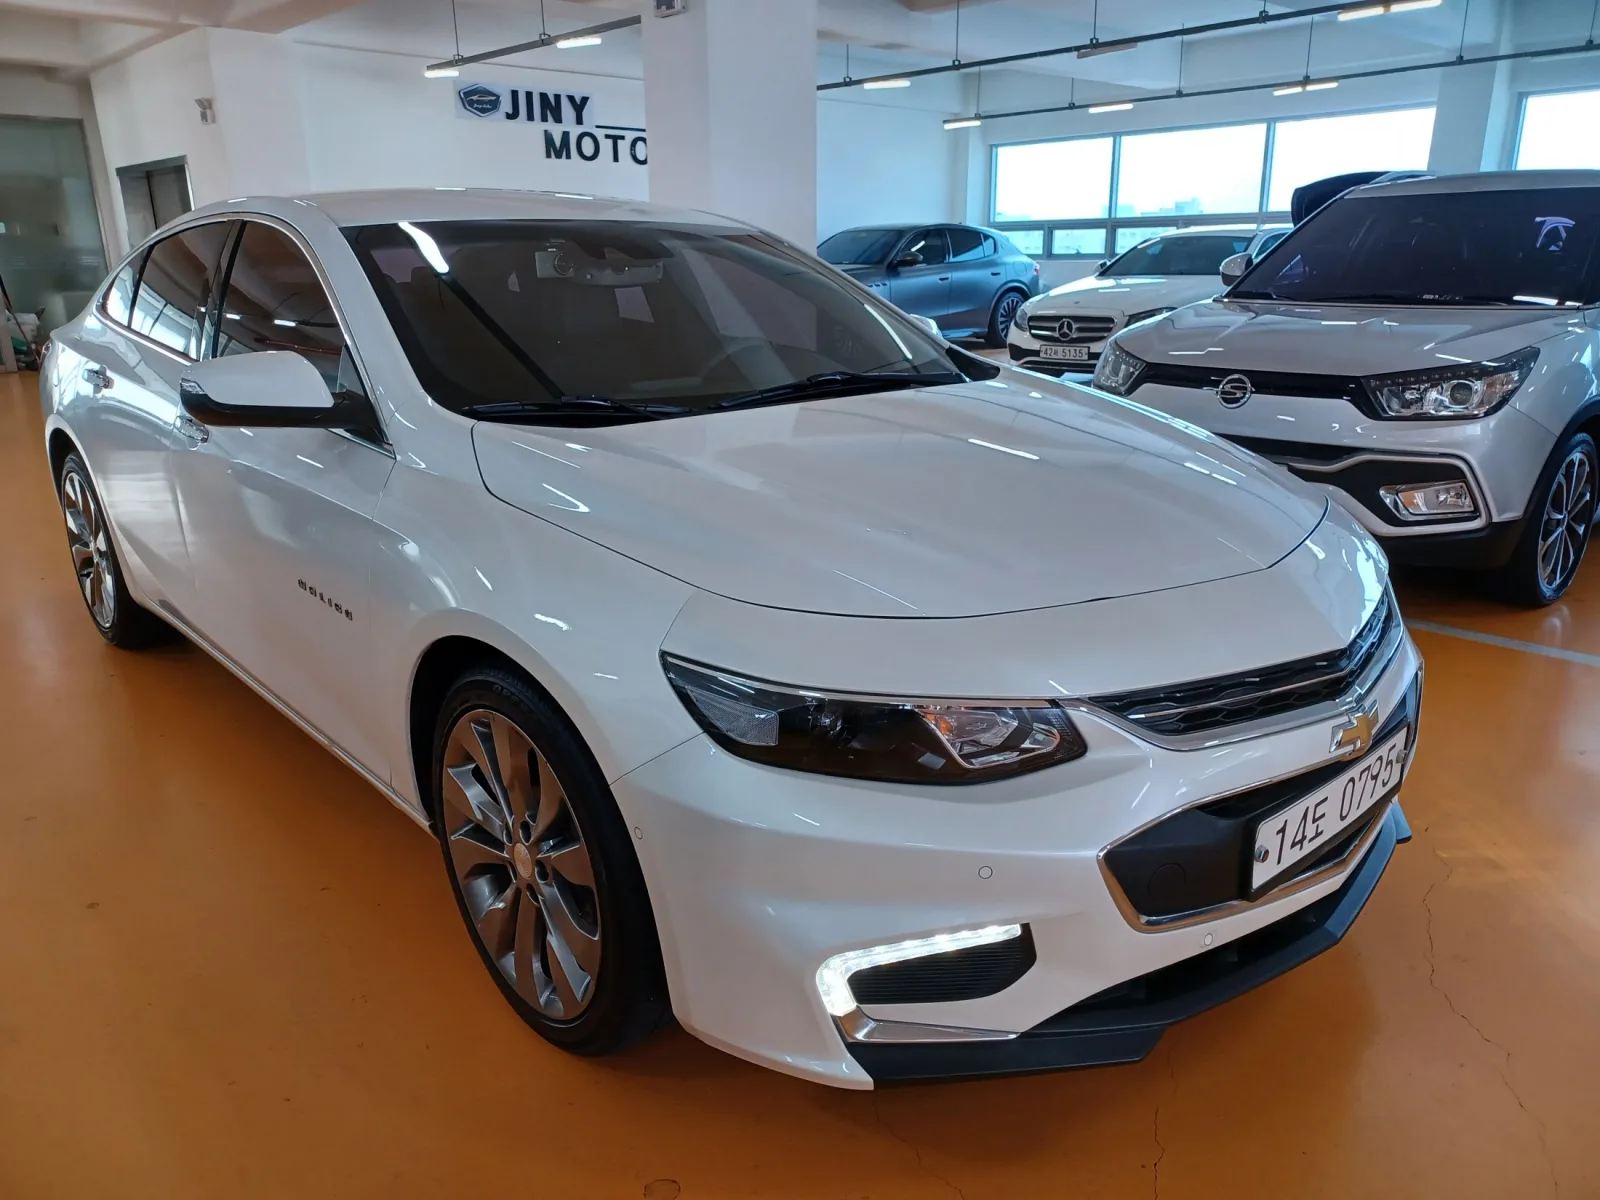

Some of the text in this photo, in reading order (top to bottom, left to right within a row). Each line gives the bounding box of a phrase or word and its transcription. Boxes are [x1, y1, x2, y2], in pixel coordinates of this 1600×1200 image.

[505, 89, 590, 126] JINY
[1062, 348, 1084, 359] 5135
[1275, 743, 1397, 866] 14도 0795
